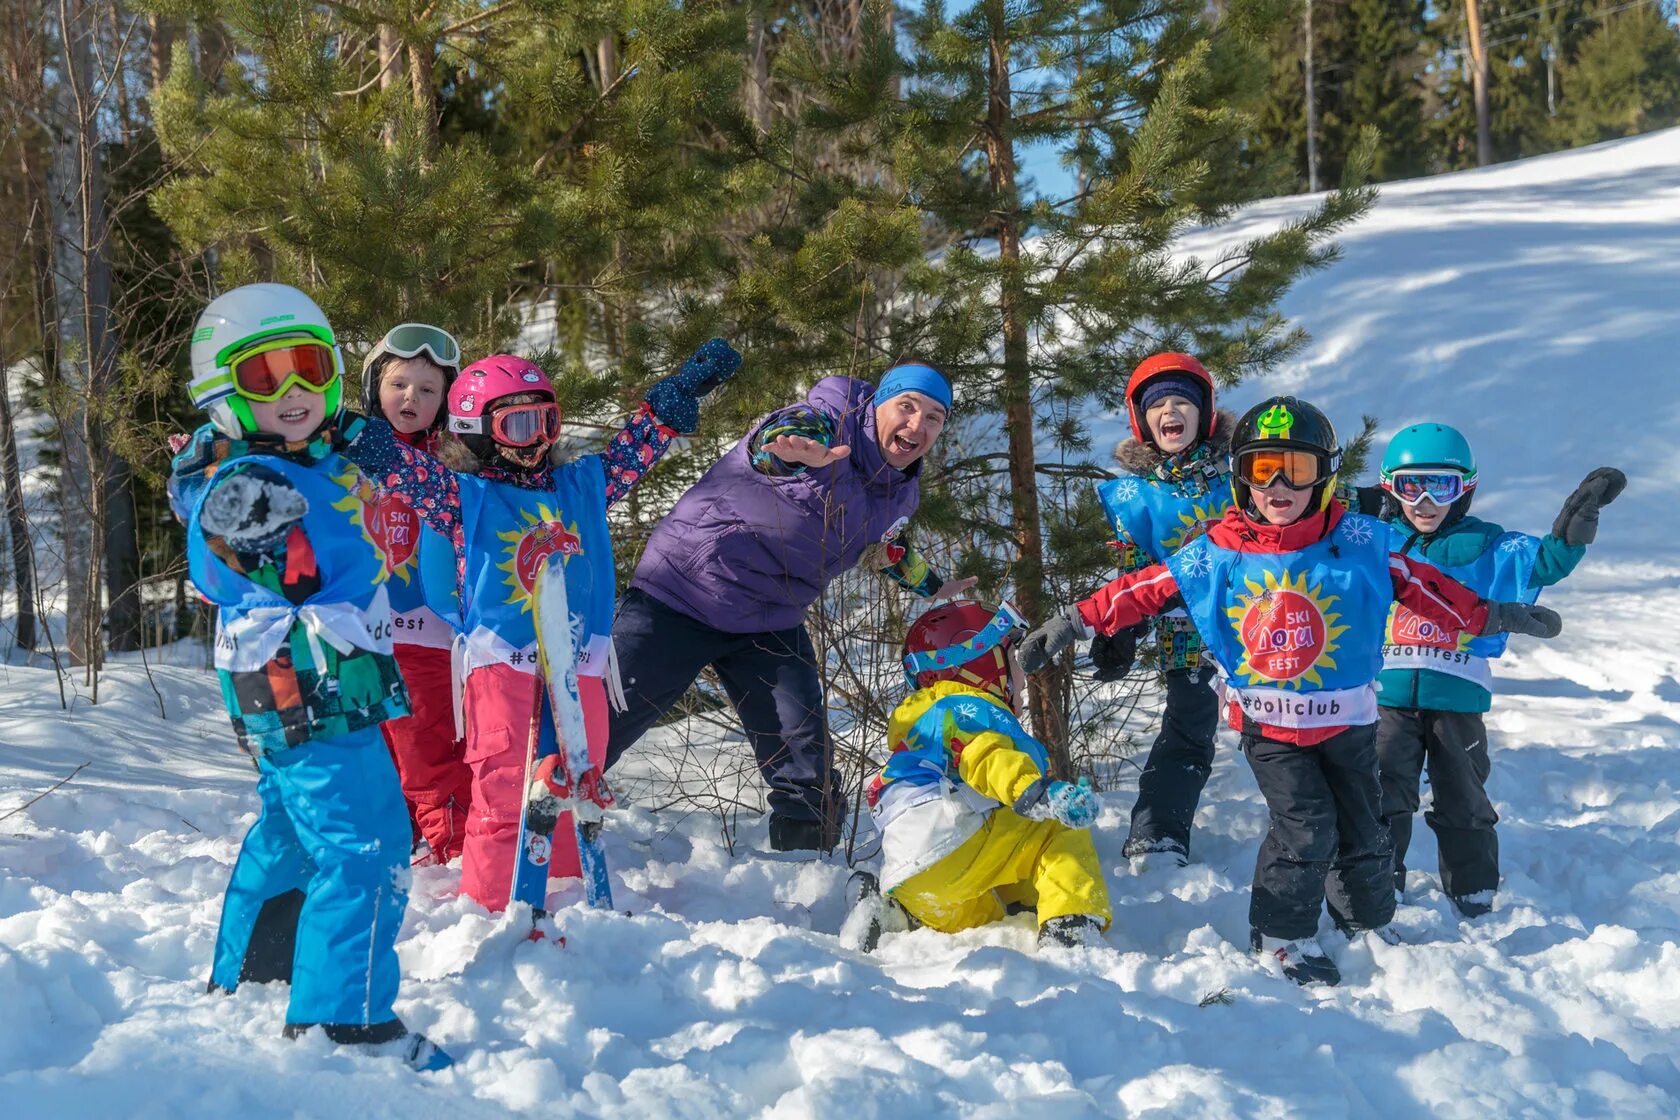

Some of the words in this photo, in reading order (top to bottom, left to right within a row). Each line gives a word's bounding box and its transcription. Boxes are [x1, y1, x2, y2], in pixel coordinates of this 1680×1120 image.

[390, 511, 410, 523] SKI
[563, 542, 580, 554] SKI
[1286, 610, 1310, 624] SKI
[1381, 644, 1471, 665] #dolifest
[1268, 657, 1300, 671] FEST
[1242, 696, 1341, 716] #doliclub
